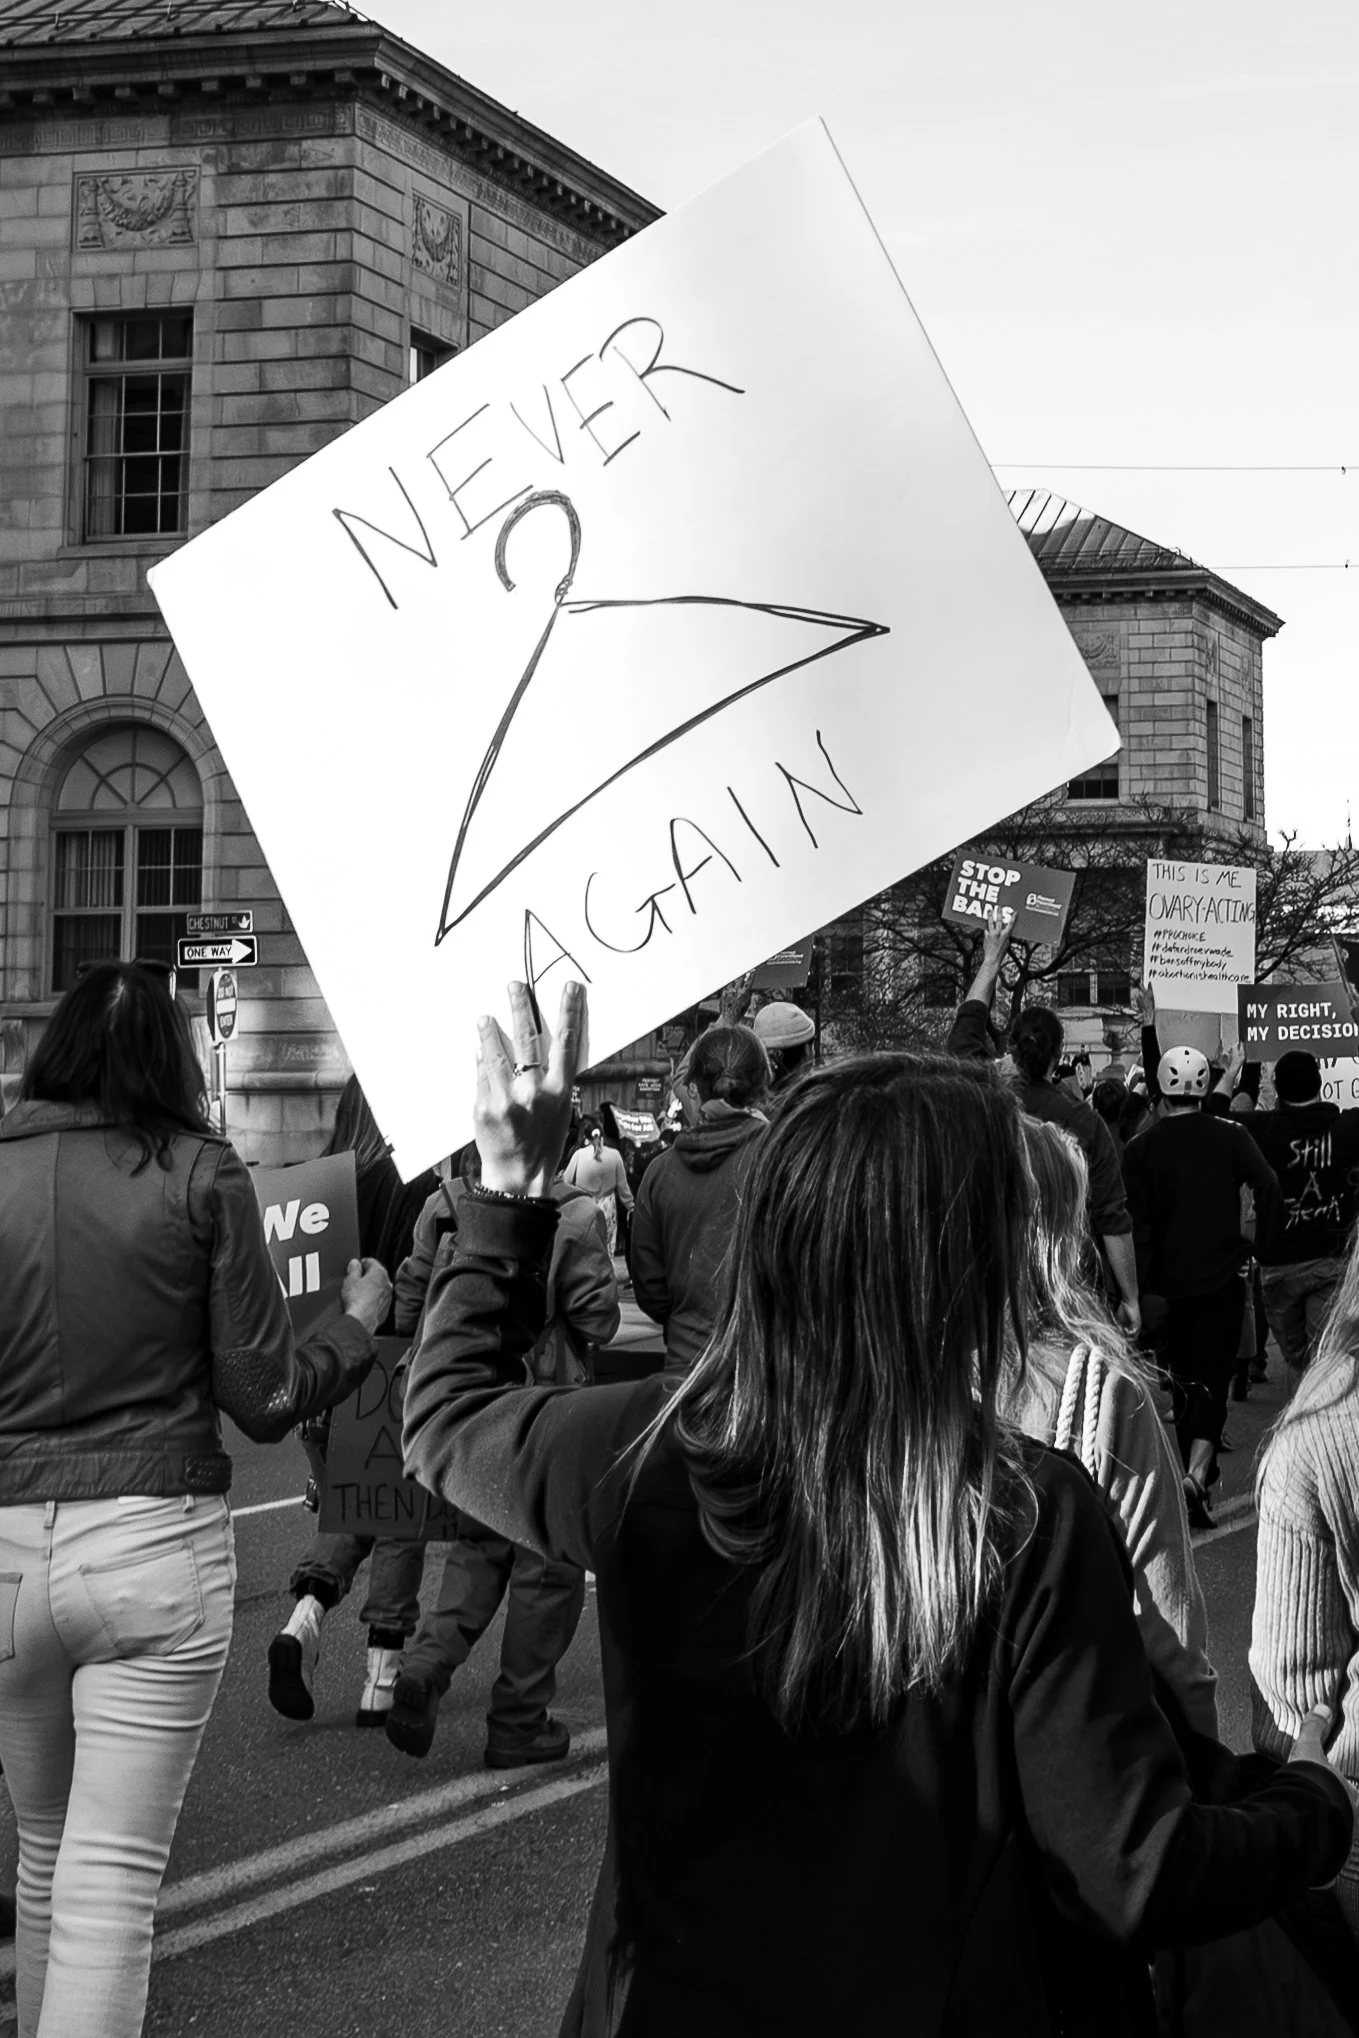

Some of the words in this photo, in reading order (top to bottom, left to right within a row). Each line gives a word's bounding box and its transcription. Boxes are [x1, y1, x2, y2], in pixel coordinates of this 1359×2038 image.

[333, 317, 746, 610] NEVER
[522, 730, 863, 988] AGAIN
[959, 860, 1021, 887] STOP
[957, 877, 1000, 903] THE
[1152, 863, 1185, 882] THIS
[1195, 867, 1210, 885] IS
[1216, 870, 1242, 888] ME
[189, 916, 229, 930] CHESTNUT
[952, 894, 1014, 924] BANS
[187, 947, 208, 959] ONE
[211, 946, 232, 958] WAY
[1246, 1003, 1268, 1019] MY
[1277, 1002, 1337, 1019] RIGHT,
[1247, 1026, 1269, 1042] MY
[1286, 1130, 1332, 1169] Still
[1300, 1170, 1323, 1202] A
[263, 1198, 331, 1246] We
[274, 1251, 321, 1299] ll
[331, 1483, 414, 1524] THEN
